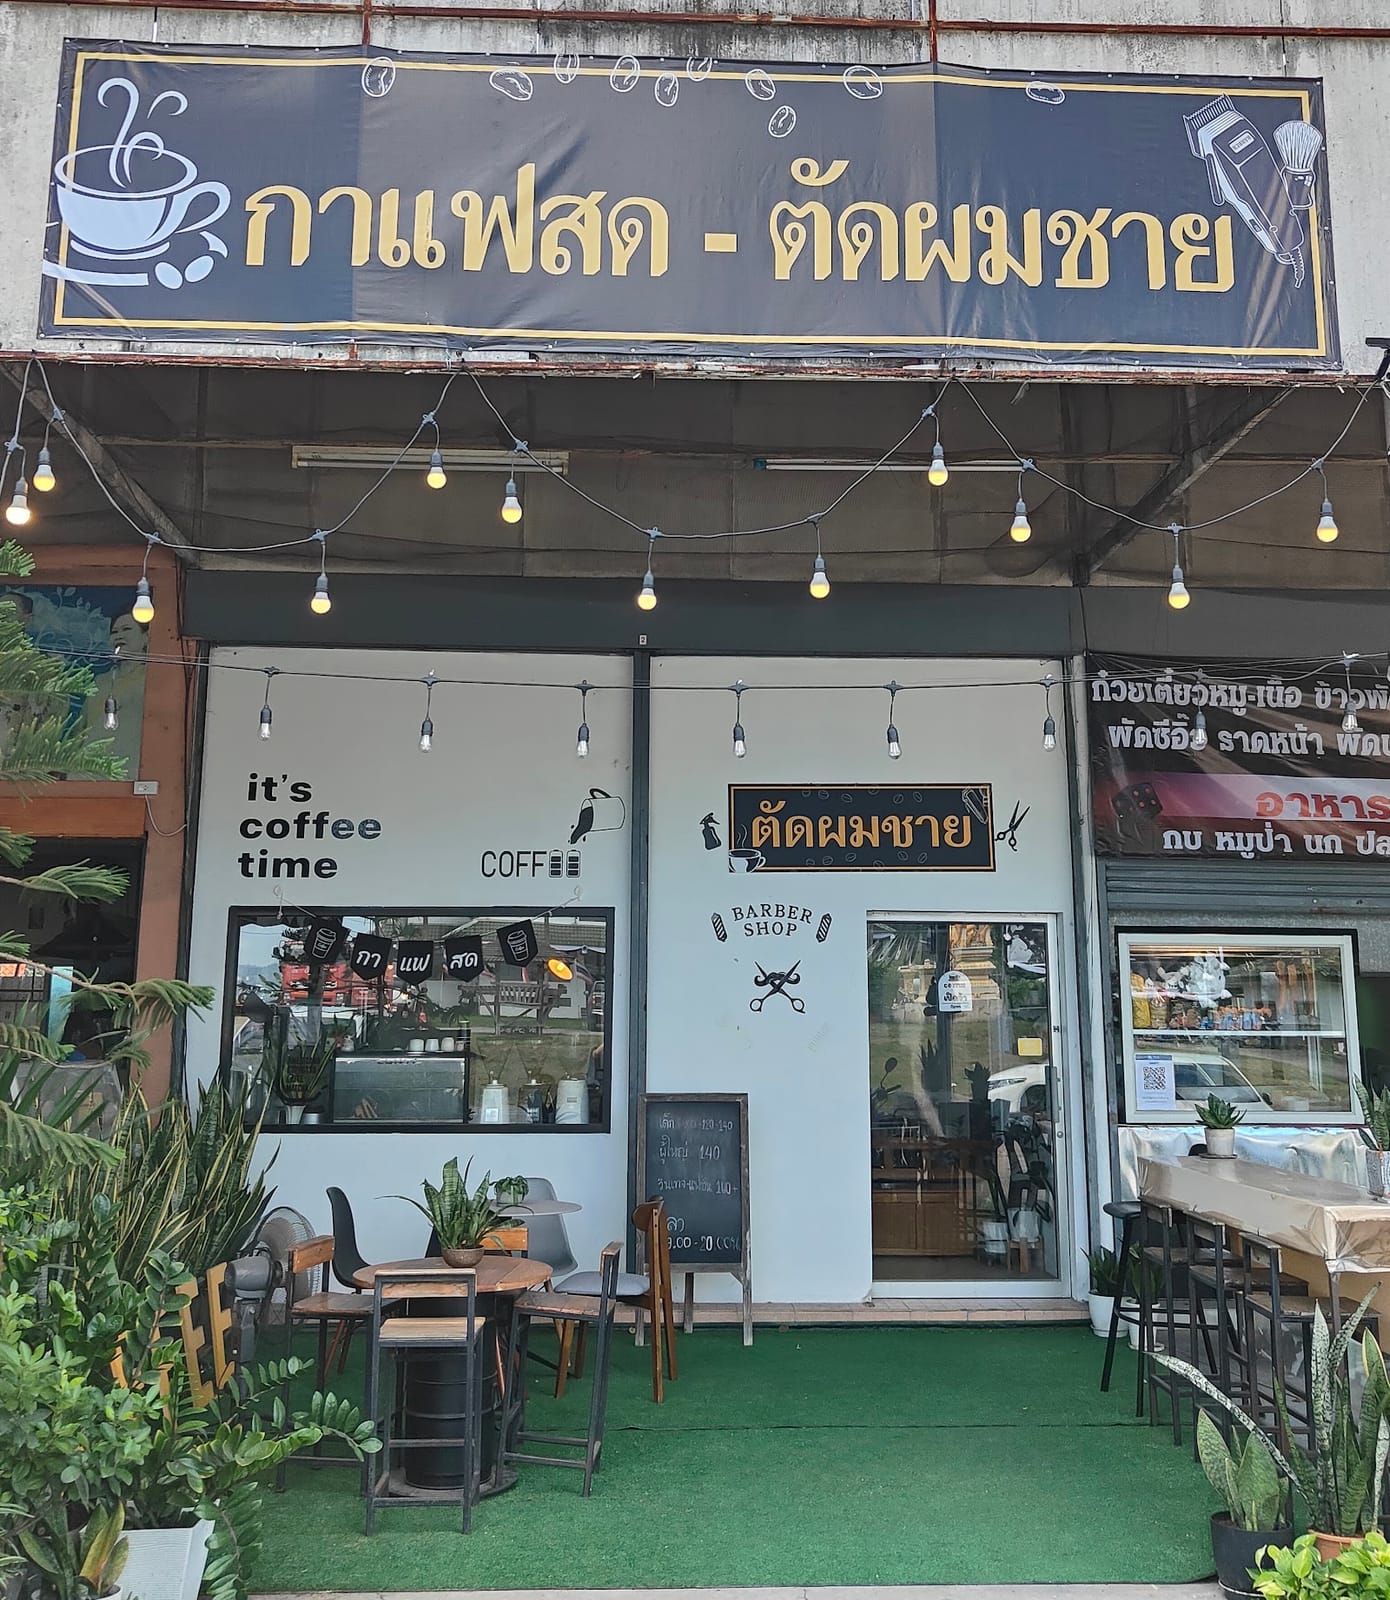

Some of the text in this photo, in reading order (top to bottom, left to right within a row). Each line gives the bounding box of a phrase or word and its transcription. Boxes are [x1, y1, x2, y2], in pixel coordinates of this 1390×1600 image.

[244, 157, 1237, 293] กาแฟสด - ตัดผมชาย
[1217, 723, 1325, 756] ราดหน้า
[247, 772, 313, 803] it's
[238, 810, 383, 840] coffee
[751, 799, 973, 849] ตัดผมชาย
[1162, 828, 1203, 850] กบ
[1215, 821, 1294, 859] หมูป่า
[1303, 833, 1345, 855] นก
[238, 848, 338, 879] time
[731, 903, 815, 926] BARBER
[743, 921, 799, 938] SHOP
[355, 950, 479, 972] กา แฟ สด
[659, 1134, 720, 1165] ผู้ใหญ่ 140
